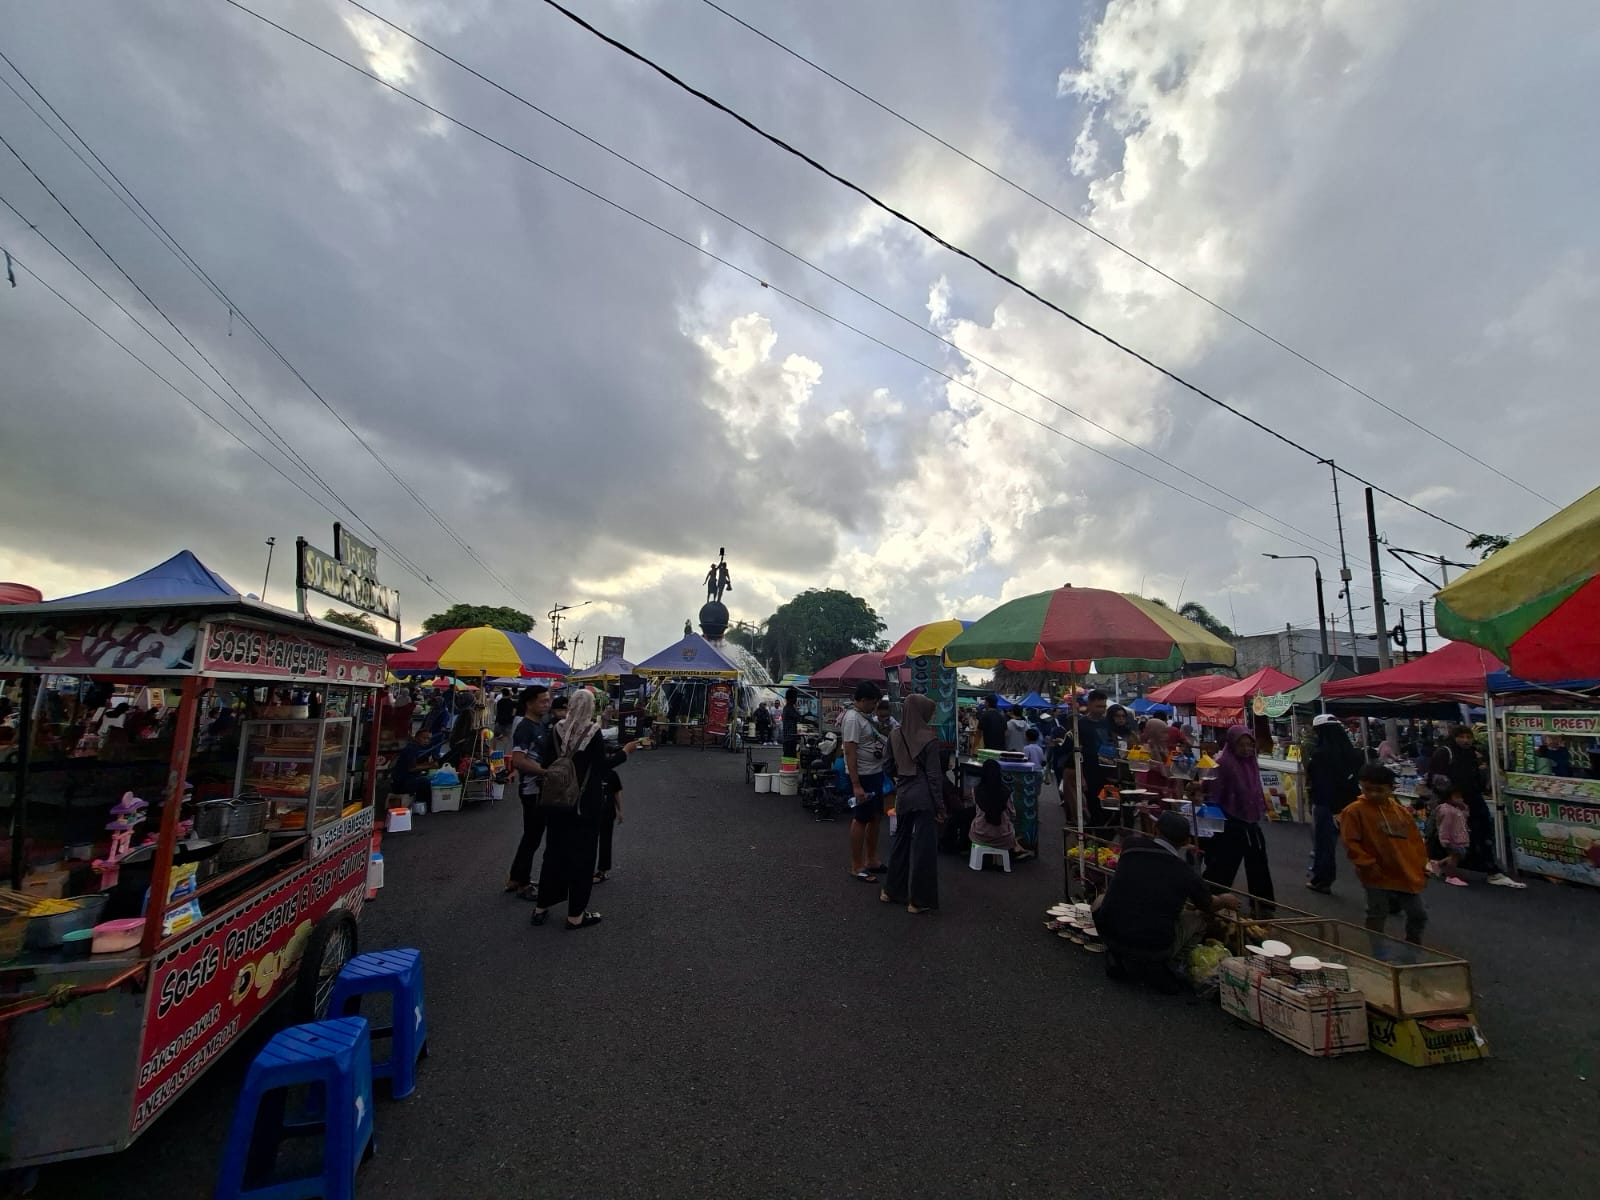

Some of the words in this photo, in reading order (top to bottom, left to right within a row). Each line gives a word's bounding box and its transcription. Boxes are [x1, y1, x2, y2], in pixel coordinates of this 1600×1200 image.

[1552, 717, 1598, 730] PREETY
[1558, 805, 1600, 825] PREET
[183, 1002, 222, 1051] BAKAR
